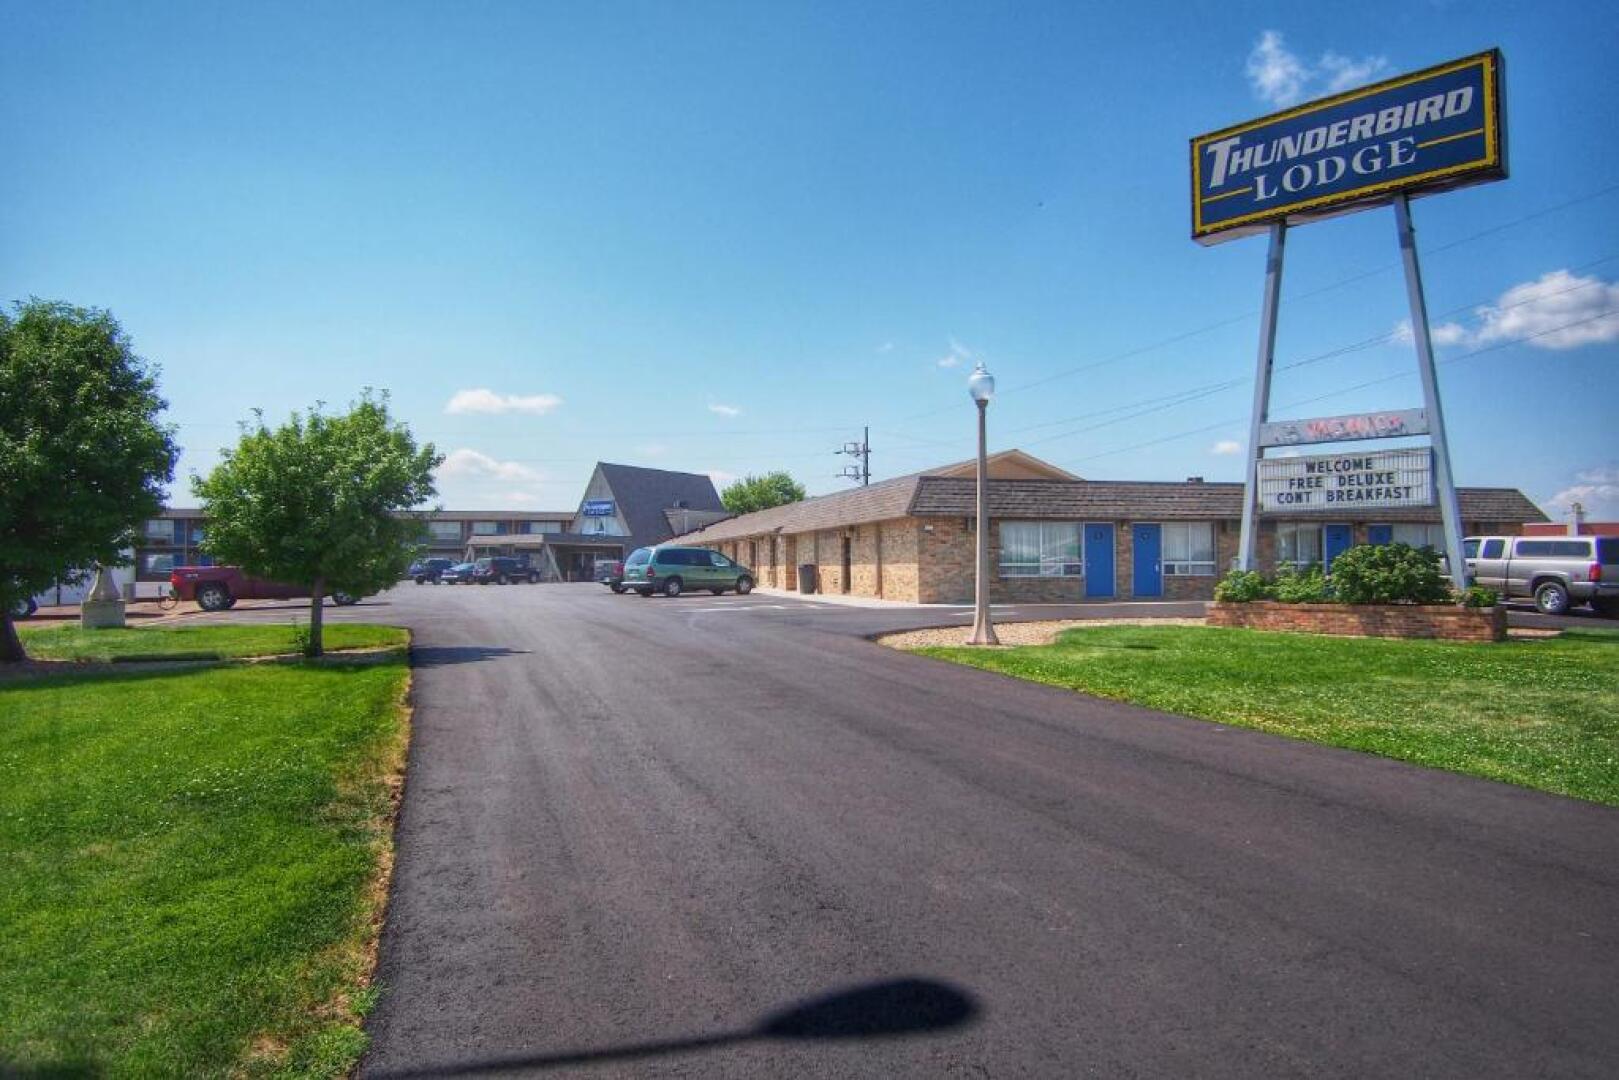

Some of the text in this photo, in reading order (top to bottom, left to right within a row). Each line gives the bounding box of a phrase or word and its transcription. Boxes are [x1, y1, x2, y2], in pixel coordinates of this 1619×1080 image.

[1207, 87, 1472, 188] THUNDERBIRD
[1253, 135, 1417, 202] LODGE
[1305, 458, 1372, 472] WELCOME
[1289, 473, 1394, 490] FREE DELUXE
[1277, 487, 1411, 503] CONT BREAKFAST
